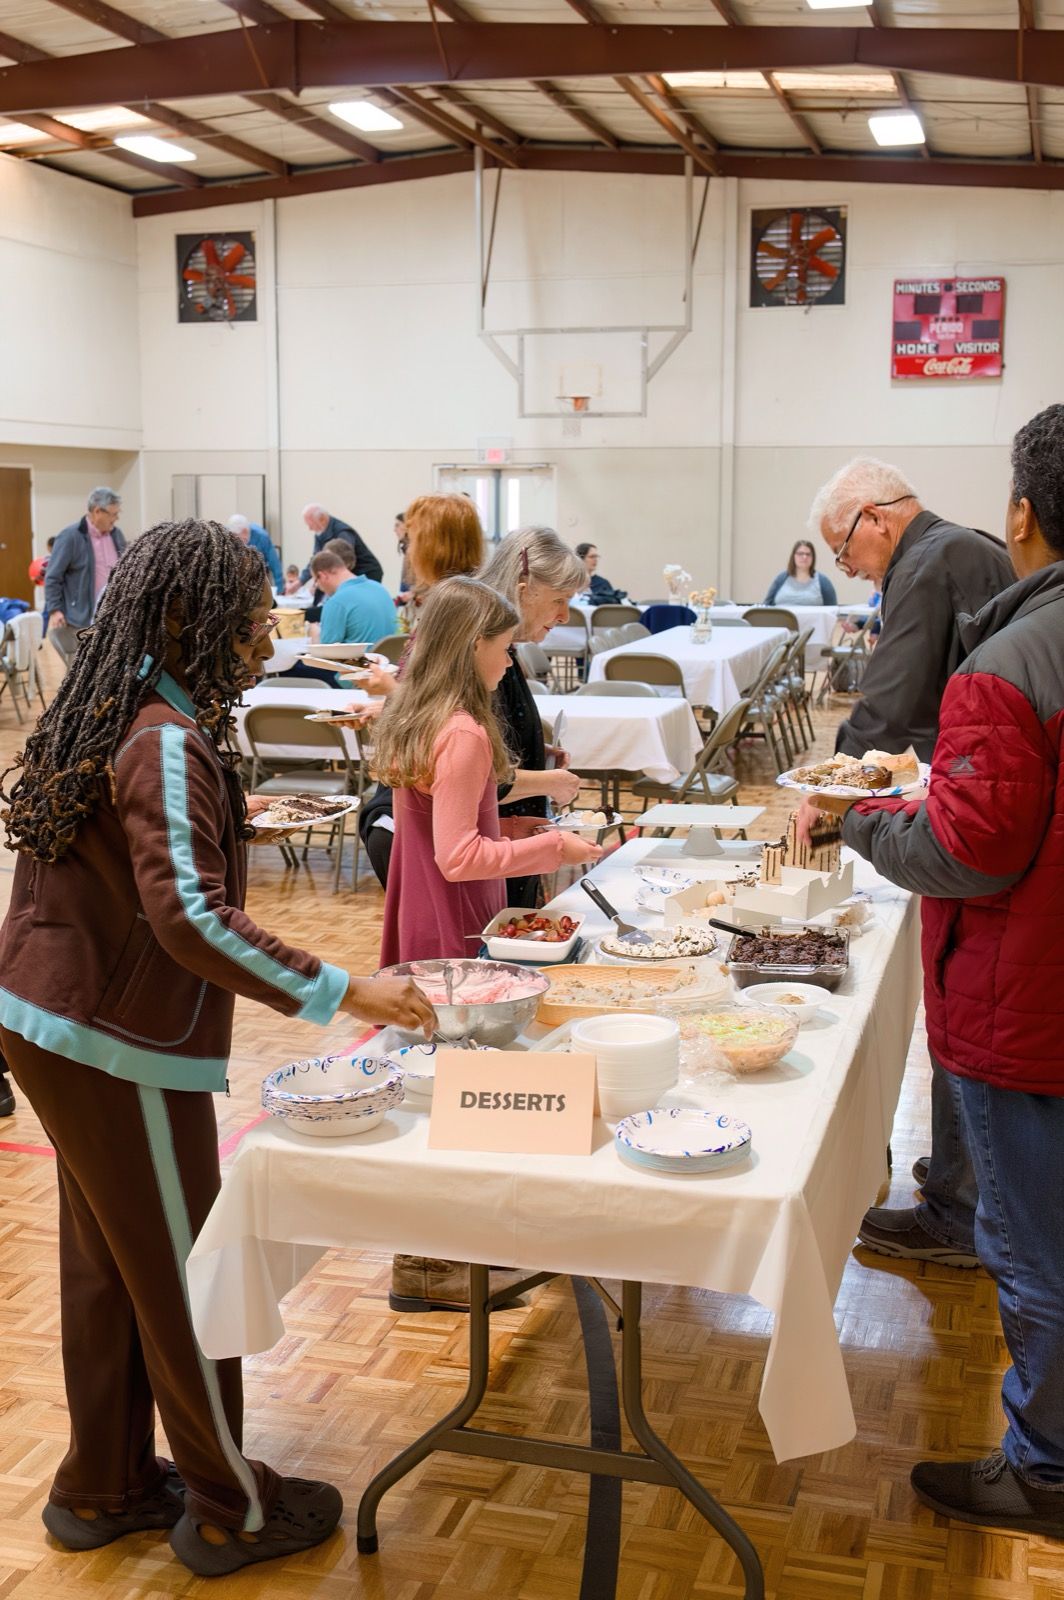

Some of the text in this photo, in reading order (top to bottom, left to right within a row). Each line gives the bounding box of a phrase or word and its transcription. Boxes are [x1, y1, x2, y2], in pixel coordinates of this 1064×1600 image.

[896, 280, 1000, 294] MINUTES SECONDS
[896, 342, 1000, 354] HOME VISITOR
[460, 1091, 566, 1112] DESSERTS
